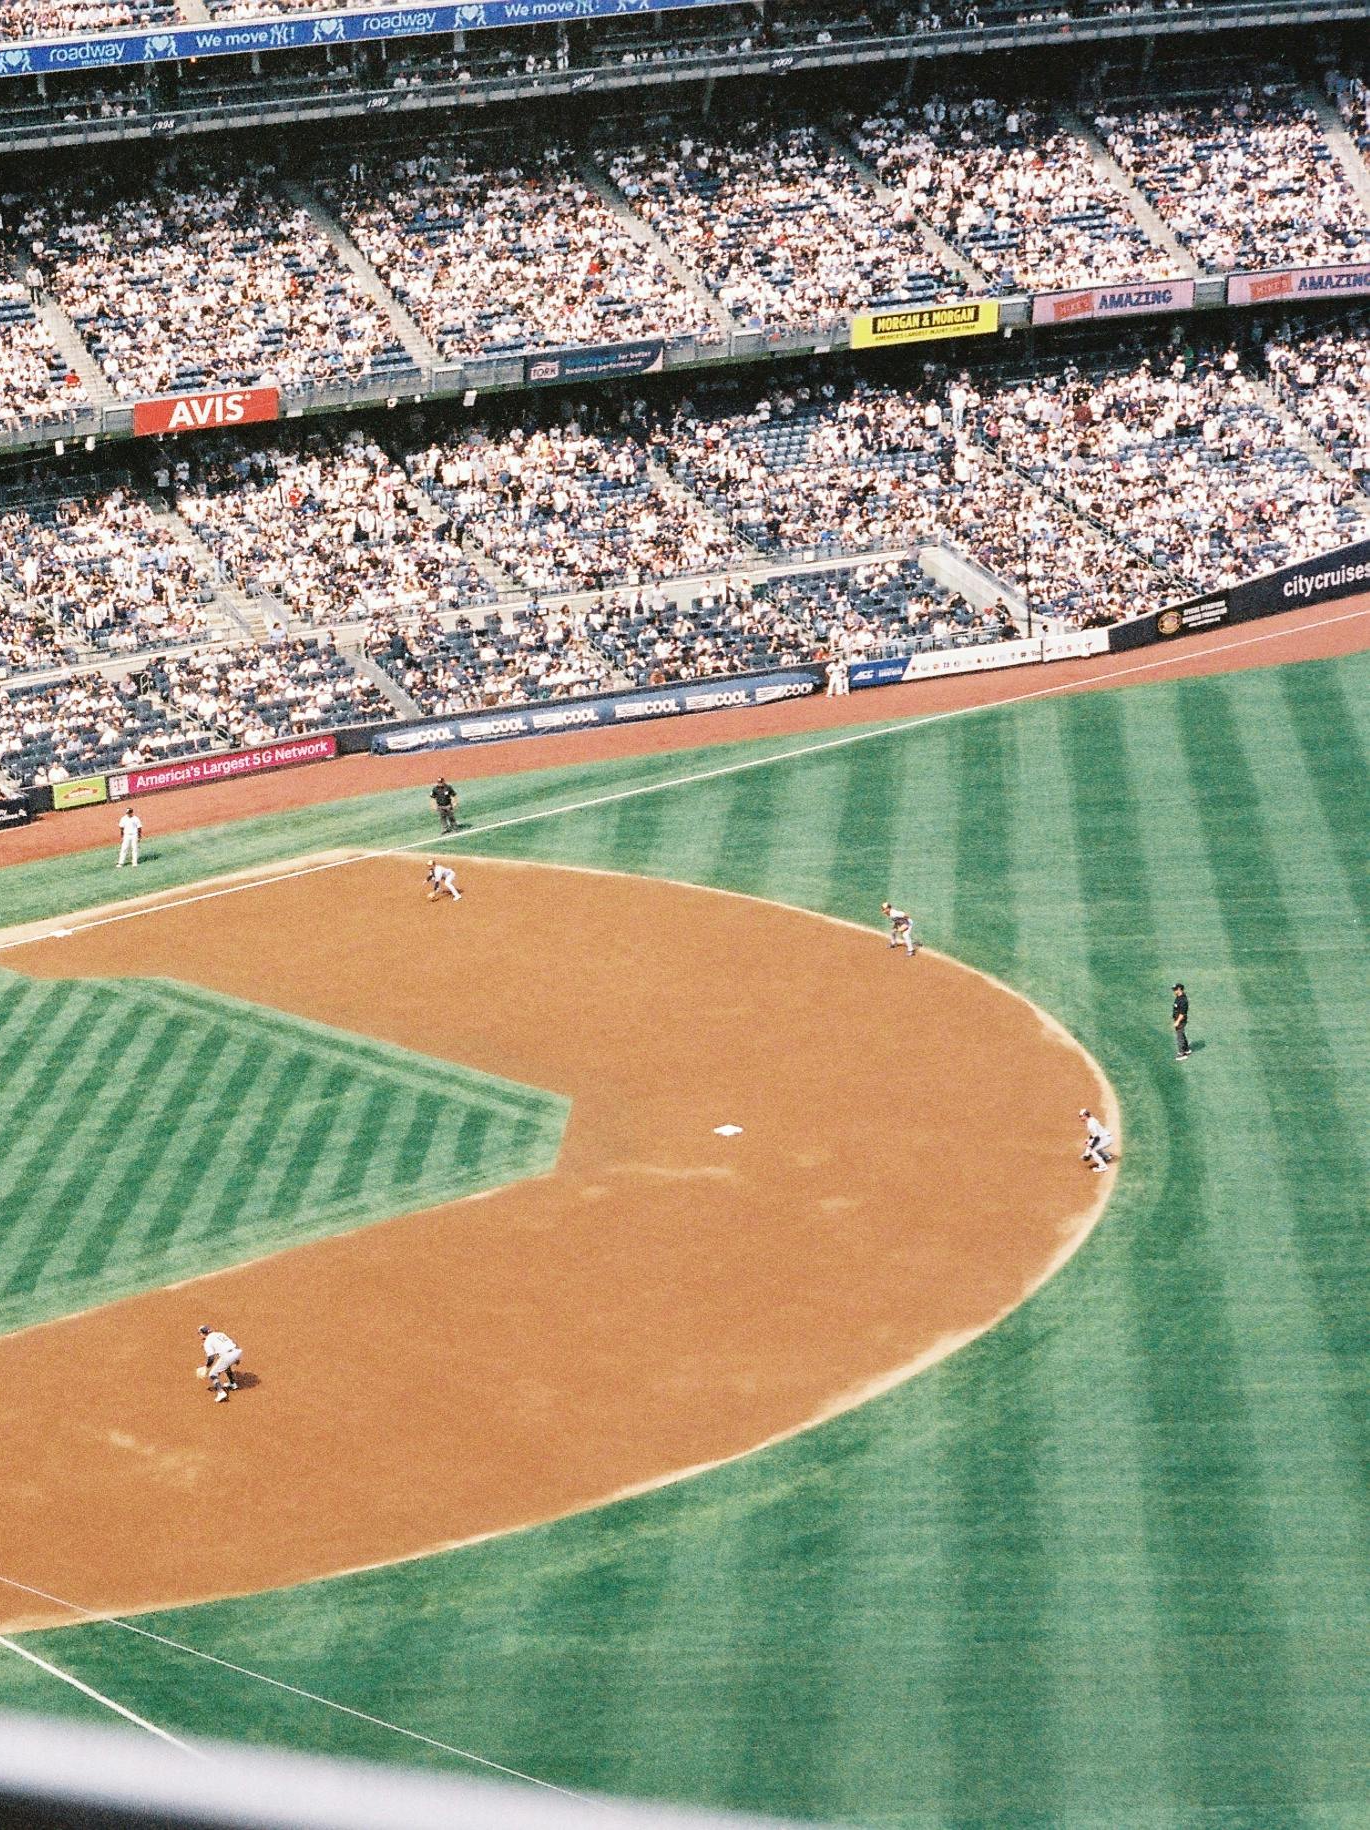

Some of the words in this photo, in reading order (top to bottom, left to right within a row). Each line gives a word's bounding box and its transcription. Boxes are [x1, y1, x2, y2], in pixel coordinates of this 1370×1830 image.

[505, 4, 529, 17] We
[533, 2, 573, 15] move
[363, 11, 436, 31] roadway
[197, 33, 222, 49] We
[225, 30, 268, 46] move
[50, 42, 125, 62] roadway
[1098, 289, 1173, 310] AMAZING
[876, 315, 920, 331] MORGAN
[921, 313, 930, 327] &
[932, 308, 975, 324] MORGAN
[533, 367, 556, 378] TORK
[168, 394, 245, 428] AVIS
[1283, 562, 1370, 597] citycruises
[136, 765, 200, 788] America's
[203, 756, 249, 775] Largest
[252, 751, 272, 766] 5G
[275, 741, 327, 761] Network
